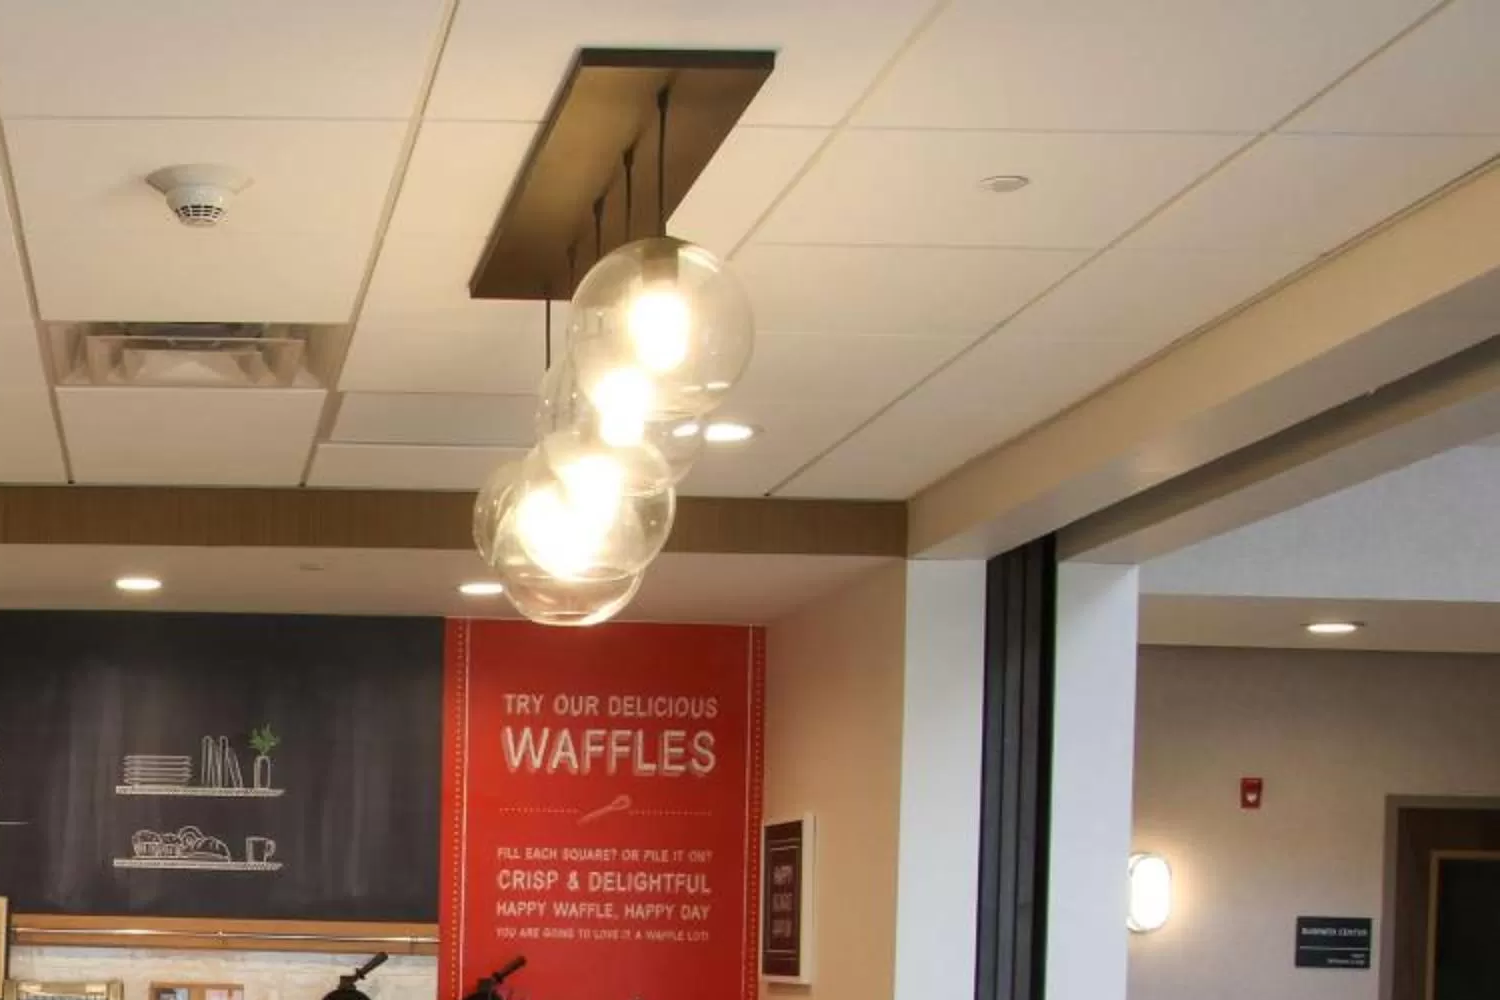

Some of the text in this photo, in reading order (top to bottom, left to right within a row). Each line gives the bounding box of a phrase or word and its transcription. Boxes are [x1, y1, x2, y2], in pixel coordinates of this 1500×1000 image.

[504, 693, 718, 719] TRY OUR DELICIOUS
[503, 726, 716, 776] WAFFLES
[497, 846, 521, 860] FILL
[525, 847, 557, 861] EACH
[562, 847, 617, 862] SQUARE?
[622, 848, 639, 862] OR
[643, 849, 669, 863] PILE
[673, 850, 683, 862] IT
[498, 869, 711, 895] CRISP & DELIGHTFUL
[496, 900, 547, 918] HAPPY
[624, 903, 676, 921] HAPPY
[681, 904, 711, 922] DAY
[520, 927, 539, 940] ARE
